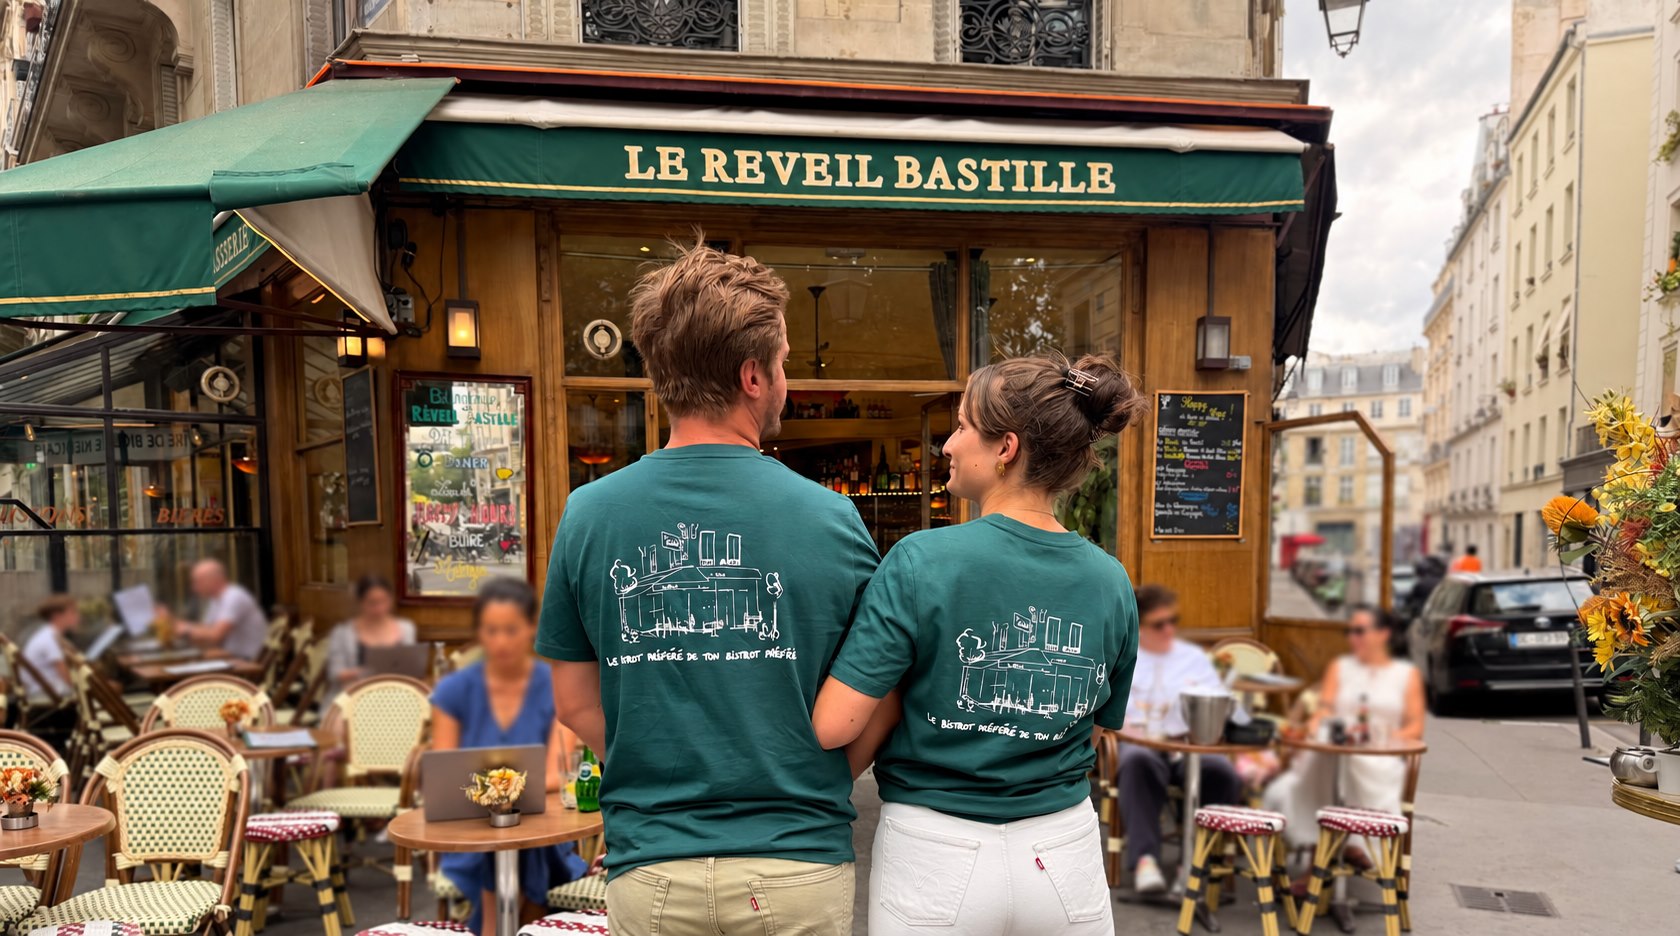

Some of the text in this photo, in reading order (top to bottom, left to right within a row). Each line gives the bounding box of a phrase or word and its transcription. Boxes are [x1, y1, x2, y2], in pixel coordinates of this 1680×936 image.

[624, 145, 1116, 194] LE REVEIL BASTILLE
[213, 223, 249, 274] SSERIE
[687, 652, 698, 661] DE
[702, 652, 720, 661] TON
